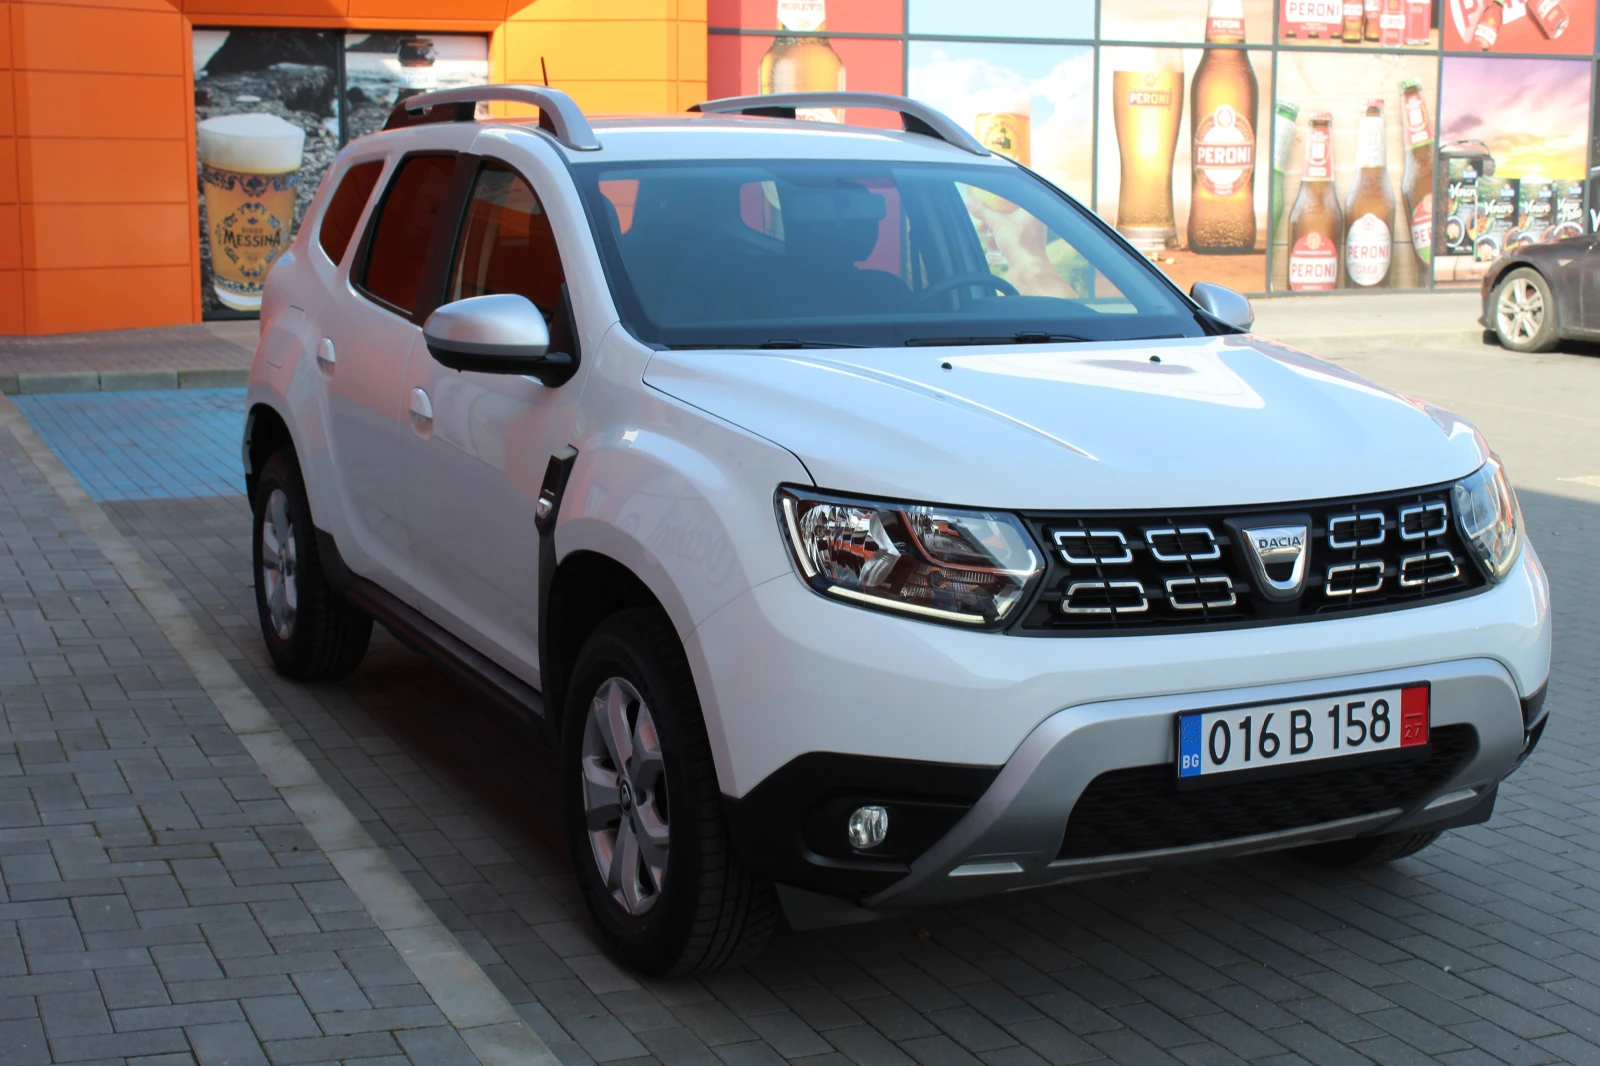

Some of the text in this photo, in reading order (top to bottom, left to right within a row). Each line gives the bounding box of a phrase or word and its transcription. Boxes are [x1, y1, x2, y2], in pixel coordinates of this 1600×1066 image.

[1290, 2, 1340, 17] PERONI
[1129, 92, 1169, 105] PERONI
[1197, 146, 1251, 164] PERONI
[223, 227, 281, 249] MESSINA
[1348, 245, 1390, 259] PERONI
[1291, 263, 1337, 278] PERONI
[1259, 536, 1301, 548] DACIA
[1404, 723, 1422, 739] 27
[1182, 754, 1199, 769] BG
